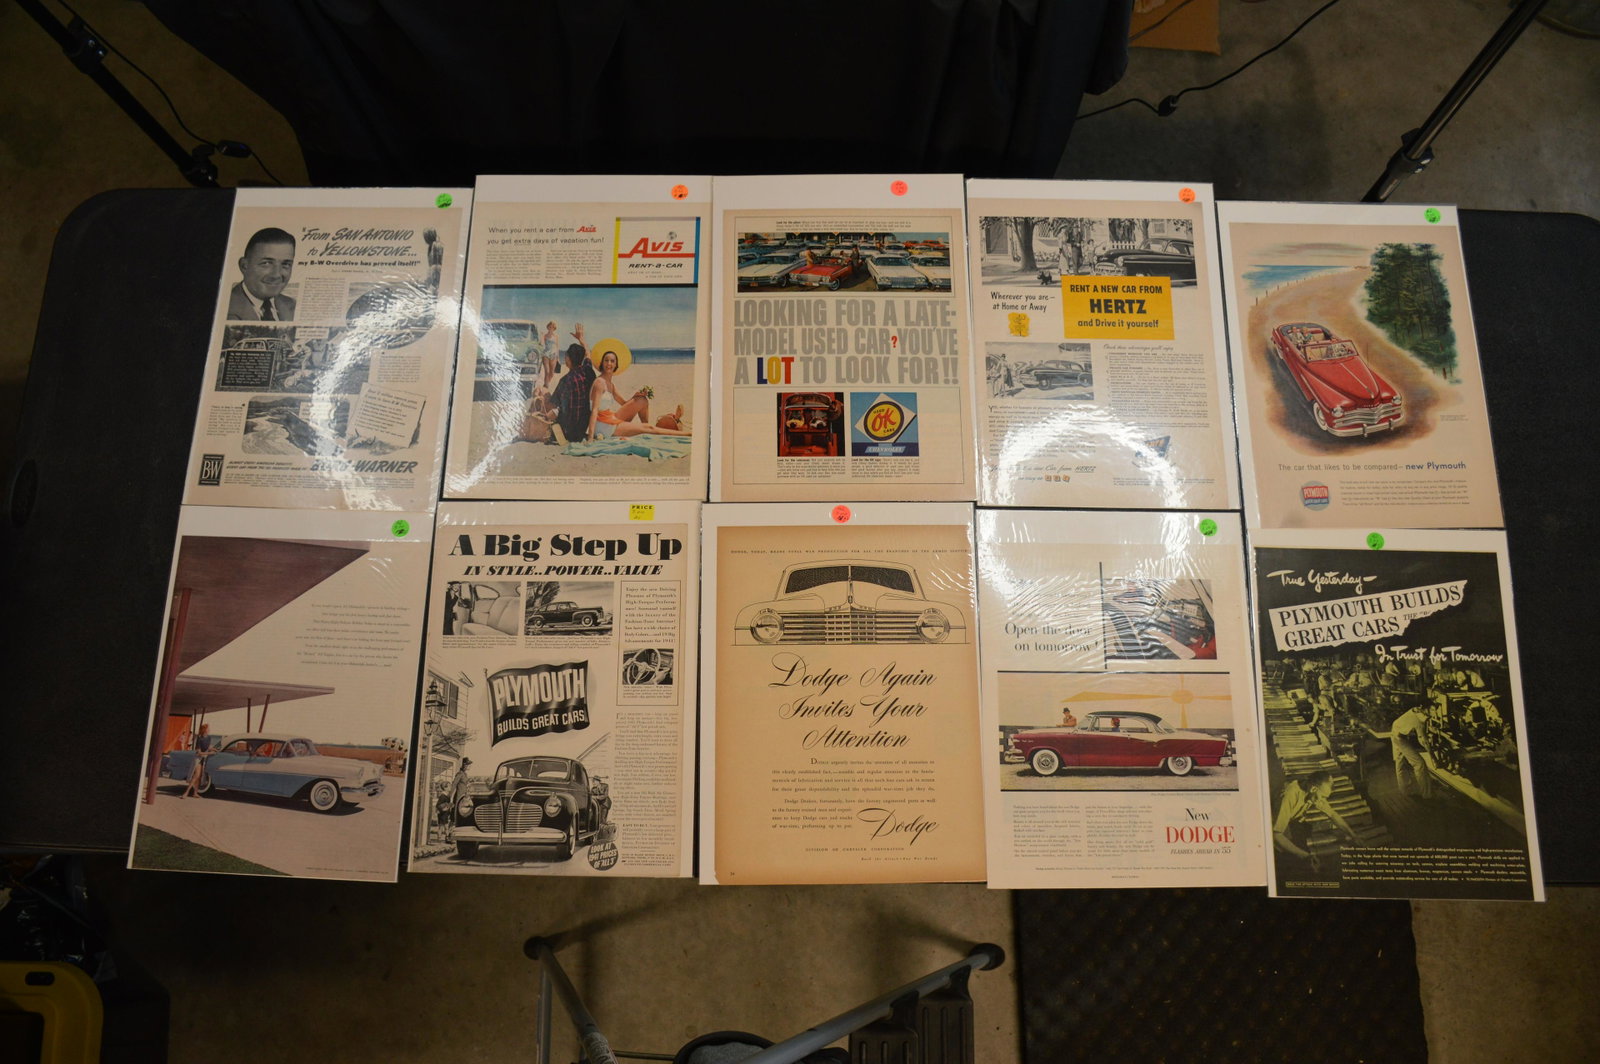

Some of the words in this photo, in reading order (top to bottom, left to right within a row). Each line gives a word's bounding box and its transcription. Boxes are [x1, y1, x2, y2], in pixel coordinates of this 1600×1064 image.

[332, 227, 363, 241] SAN
[359, 228, 414, 241] ANTONIO
[307, 246, 319, 256] to
[990, 291, 1022, 300] Wherever
[1025, 293, 1037, 301] you
[1070, 285, 1090, 293] RENT
[1093, 285, 1099, 293] A
[1101, 285, 1118, 293] NEW
[1122, 285, 1137, 293] CAR
[1140, 285, 1163, 294] FROM
[734, 300, 827, 327] LOOKING
[835, 300, 876, 326] FOR
[883, 300, 897, 326] A
[904, 300, 956, 327] LATE-
[1029, 304, 1047, 313] Away
[1089, 299, 1147, 314] HERTZ
[1078, 319, 1093, 327] and
[1096, 319, 1116, 327] Drive
[1118, 319, 1124, 327] it
[1127, 319, 1159, 329] yourself
[734, 328, 797, 356] MODEL
[802, 328, 848, 355] USED
[897, 327, 958, 356] YOU'VE
[734, 357, 750, 384] A
[757, 357, 795, 384] LOT
[800, 356, 827, 384] TO
[835, 356, 891, 384] LOOK
[871, 408, 896, 432] OK
[1427, 462, 1466, 471] Plymouth
[448, 534, 477, 556] A
[484, 534, 542, 562] Big
[550, 533, 628, 561] Step
[636, 533, 682, 561] Up
[463, 566, 485, 576] IN
[1266, 569, 1306, 587] True
[1278, 597, 1385, 627] PLYMOUTH
[1389, 585, 1461, 611] BUILDS
[1005, 622, 1038, 638] Open
[1285, 624, 1346, 648] GREAT
[1352, 616, 1400, 638] CARS
[1403, 612, 1418, 621] THE
[1014, 643, 1030, 651] on
[1375, 644, 1394, 664] In
[1390, 646, 1427, 661] Trust
[1429, 646, 1447, 666] for
[1441, 646, 1504, 663] Tomorrow
[768, 652, 851, 696] Dodge
[859, 661, 937, 695] Again
[492, 668, 585, 710] PLYMOUTH
[778, 693, 855, 720] Invites
[860, 695, 928, 728] Your
[497, 718, 529, 736] BUILDS
[532, 713, 559, 729] GREAT
[562, 710, 585, 725] CARS
[802, 724, 910, 751] Attention
[1185, 808, 1210, 821] New
[856, 807, 940, 846] Dodge
[1166, 826, 1235, 844] DODGE
